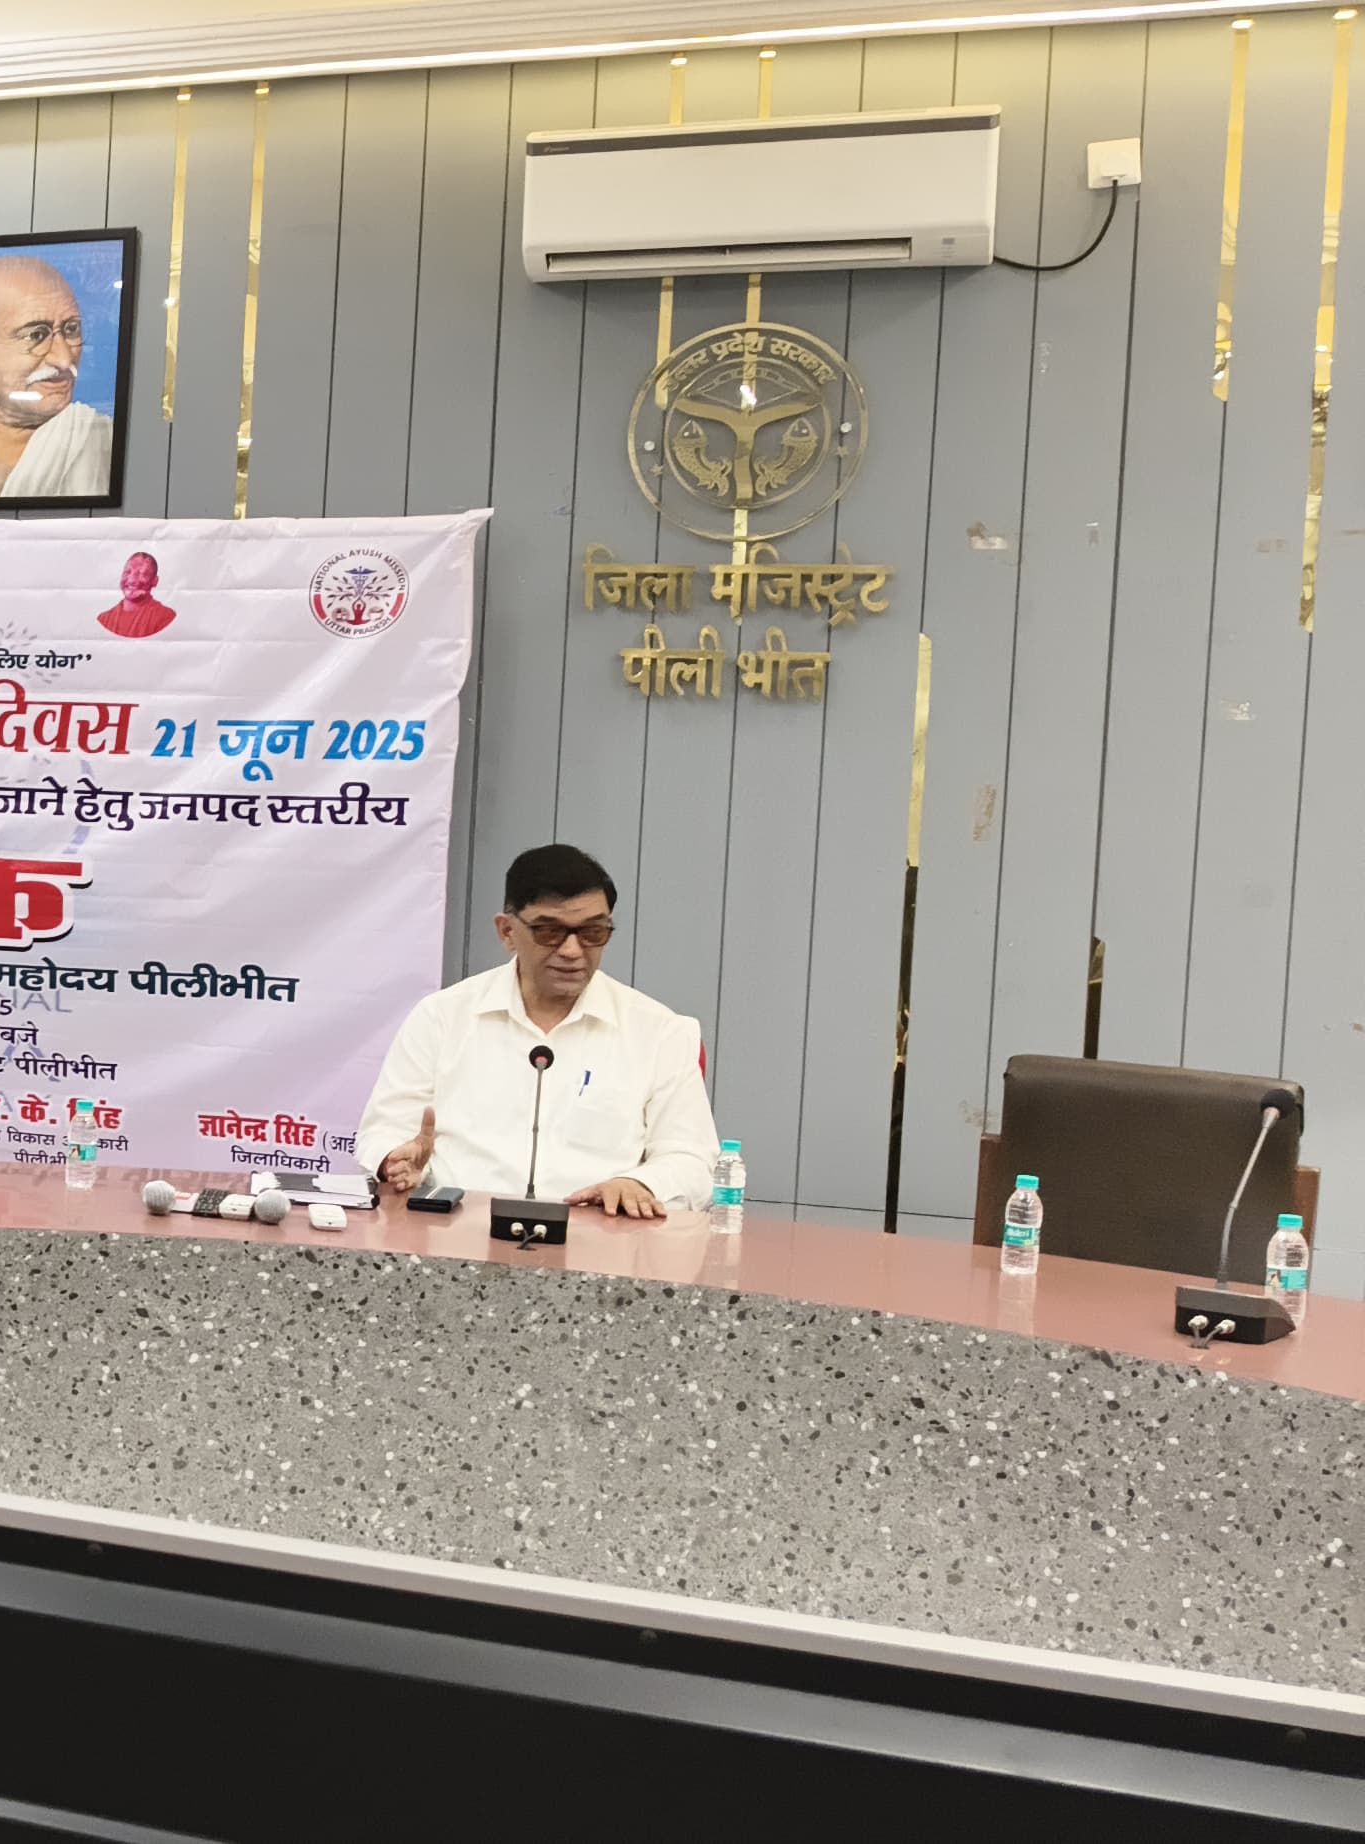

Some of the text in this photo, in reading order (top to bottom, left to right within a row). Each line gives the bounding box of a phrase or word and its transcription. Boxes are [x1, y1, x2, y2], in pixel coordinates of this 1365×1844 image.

[314, 549, 406, 592] NATIONAL AYUSH MISSION
[583, 543, 698, 612] जिला
[324, 617, 392, 635] UTTAR PRADESH
[621, 624, 831, 699] पीली भीत
[151, 718, 198, 758] 21
[217, 719, 315, 782] जून
[322, 719, 427, 761] 2025
[73, 777, 133, 831] हेतु
[139, 792, 263, 828] जनपद
[267, 782, 410, 827] स्तरीय
[129, 961, 300, 1002] पीलीभीत
[0, 1021, 40, 1046] बजे
[14, 1052, 118, 1081] पीलीभीत
[18, 1094, 58, 1125] के.
[6, 1127, 56, 1146] विकास
[198, 1110, 269, 1142] ज्ञानेन्द्र
[273, 1114, 318, 1146] सिंह
[13, 1148, 67, 1164] पीलीभी
[230, 1144, 332, 1173] जिलाधिकारी
